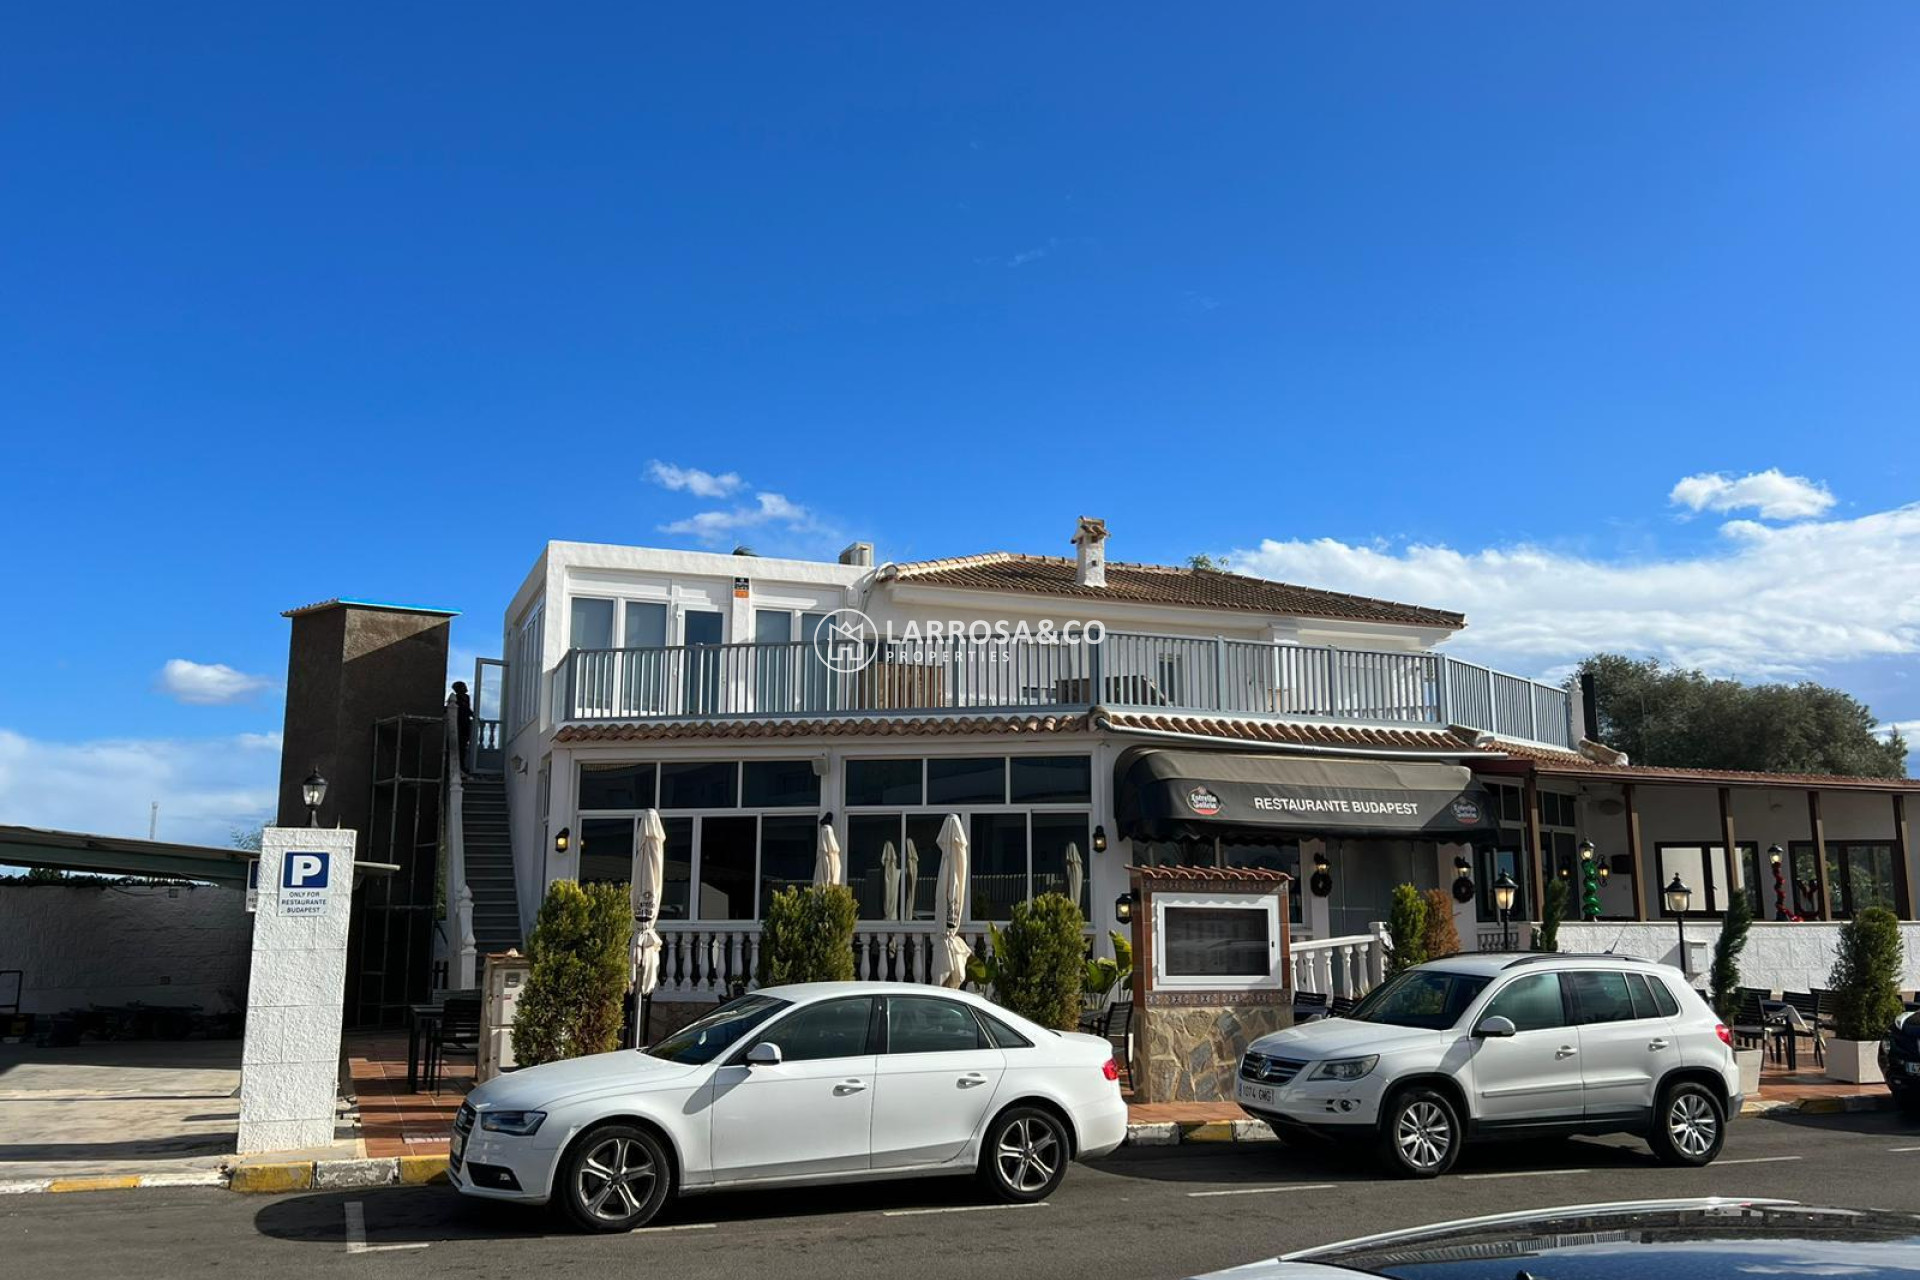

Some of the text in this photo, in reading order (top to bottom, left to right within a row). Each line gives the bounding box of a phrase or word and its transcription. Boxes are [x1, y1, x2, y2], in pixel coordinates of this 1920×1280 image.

[1254, 797, 1418, 815] RESTAURANTE BUDAPEST
[291, 855, 323, 886] P
